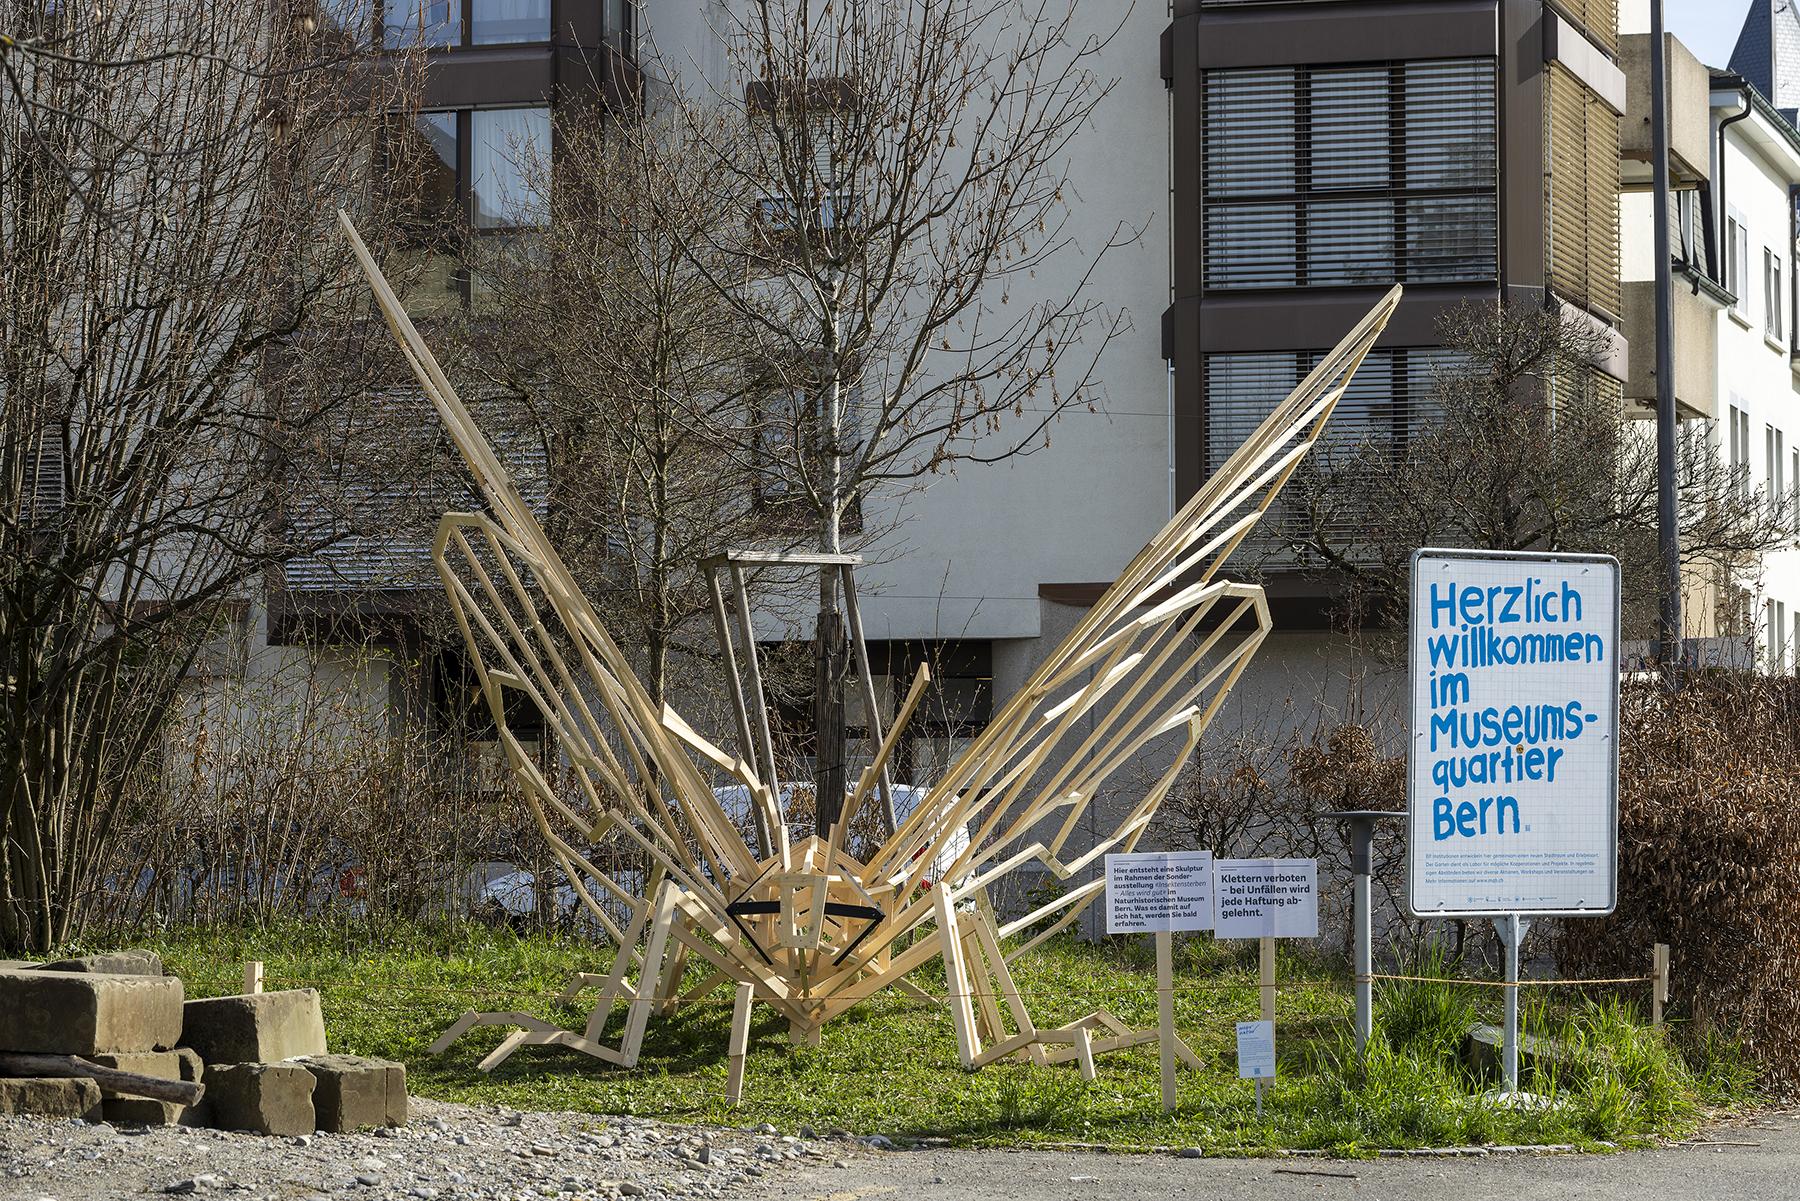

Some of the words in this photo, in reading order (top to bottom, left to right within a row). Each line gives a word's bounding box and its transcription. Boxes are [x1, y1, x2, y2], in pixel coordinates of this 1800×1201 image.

[1430, 577, 1582, 628] Herzlich
[1428, 624, 1604, 668] willkommen
[1430, 671, 1469, 709] im
[1430, 700, 1598, 752] Museums-
[1432, 745, 1564, 794] quartier
[1222, 874, 1261, 883] Klettern
[1262, 874, 1306, 882] verboten
[1230, 886, 1244, 894] bei
[1247, 885, 1287, 894] Unfällen
[1290, 884, 1310, 893] wird
[1221, 897, 1242, 908] jede
[1245, 896, 1284, 907] Haftung
[1287, 896, 1302, 904] ab-
[1222, 908, 1262, 919] gelehnt.
